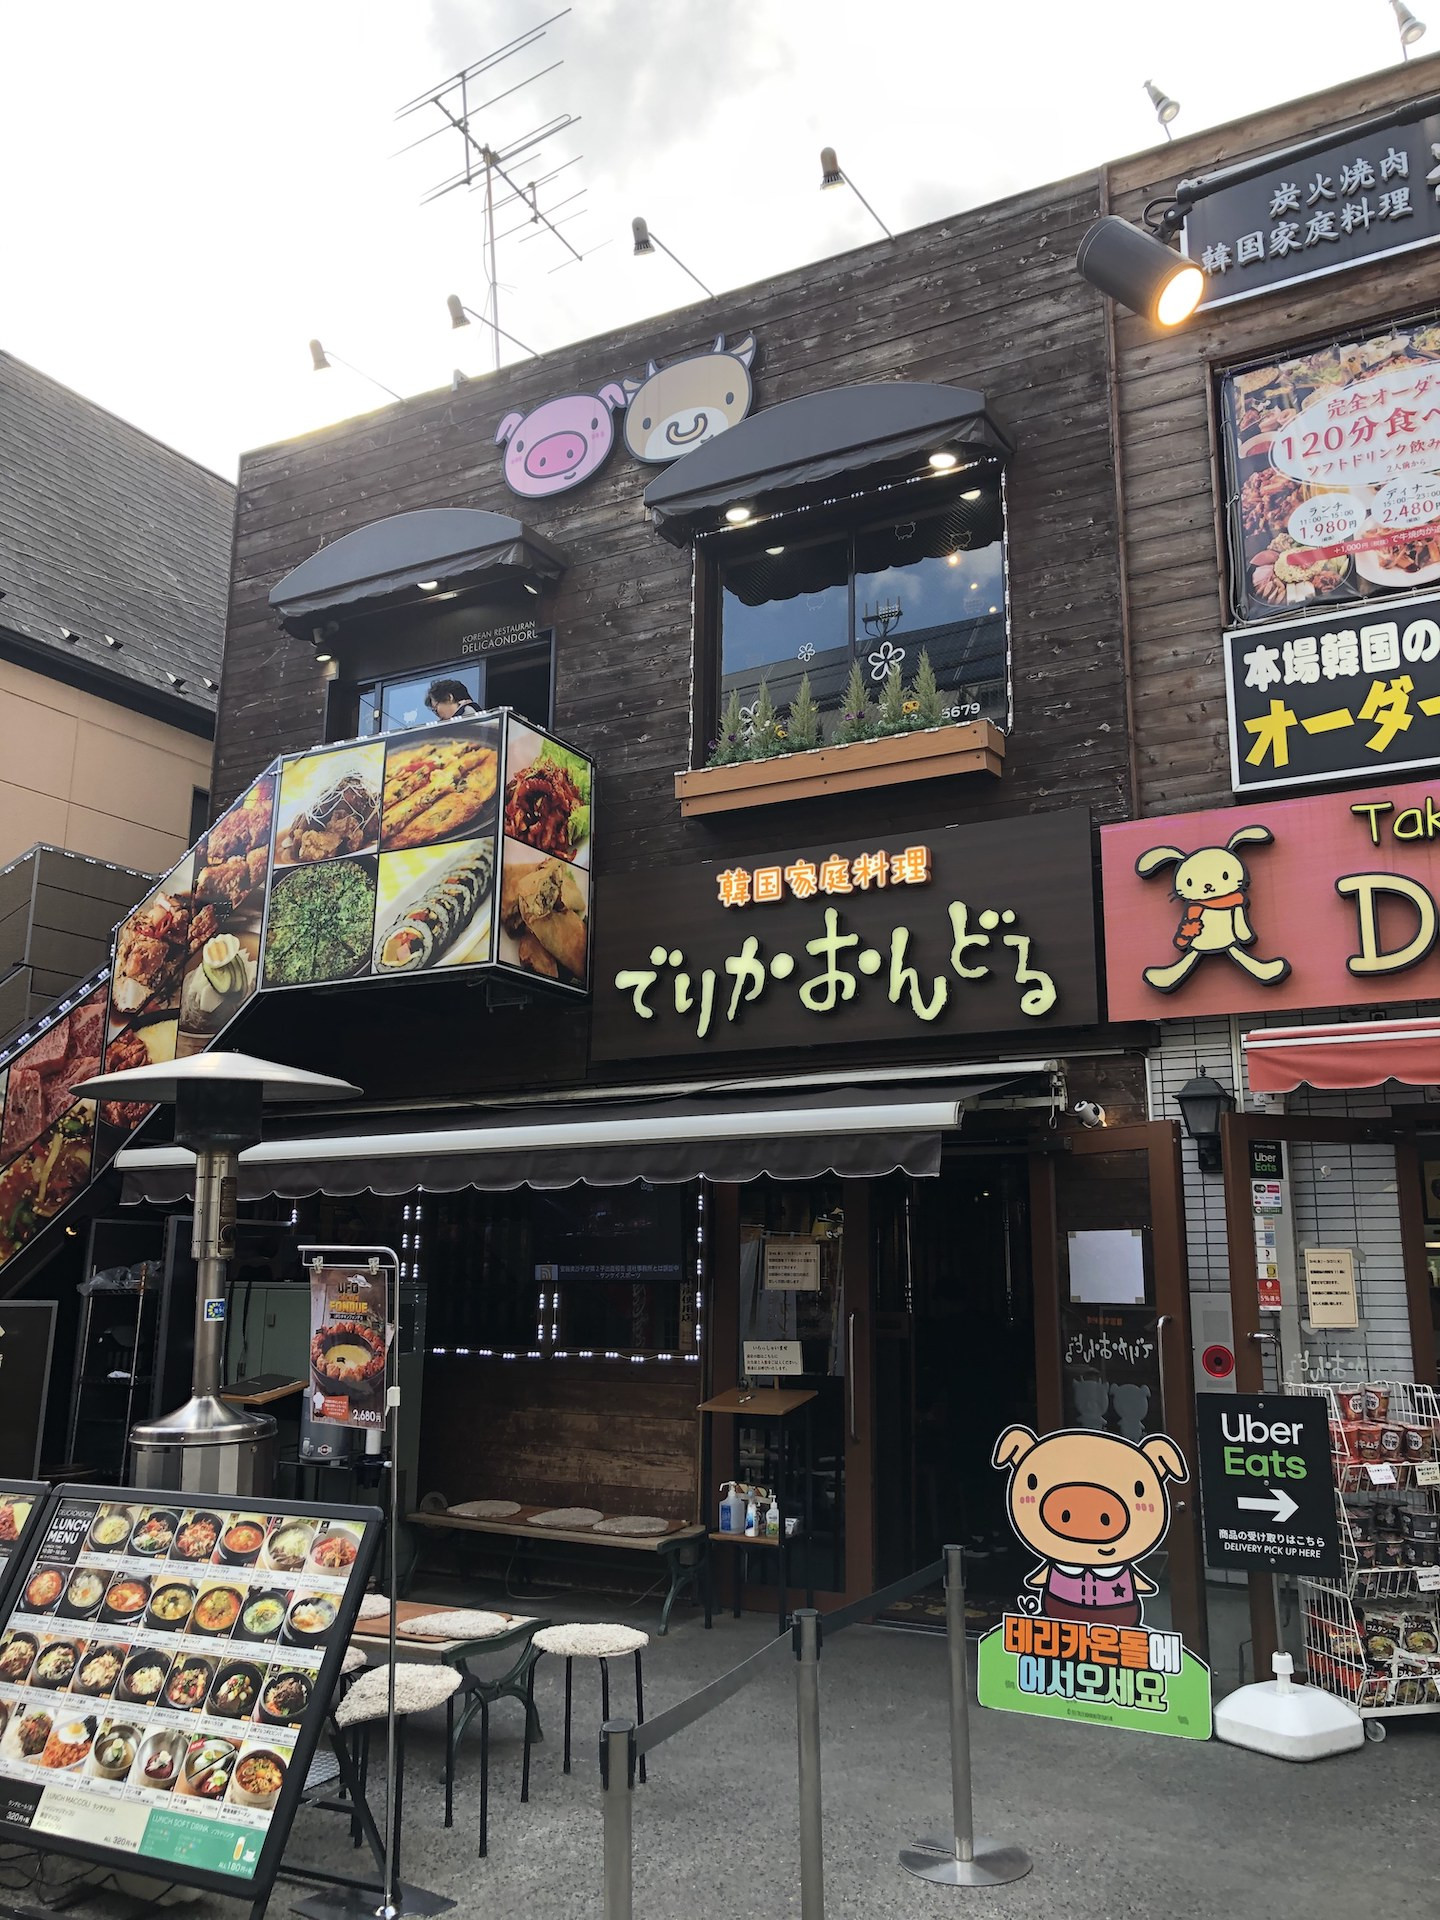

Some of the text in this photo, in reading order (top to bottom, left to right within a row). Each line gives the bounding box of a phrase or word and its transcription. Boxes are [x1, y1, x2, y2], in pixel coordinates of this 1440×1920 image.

[1269, 147, 1409, 218] 炭火焼肉
[1201, 186, 1414, 276] 韓国家庭料理
[1327, 374, 1440, 419] 完全オーダ
[1309, 501, 1343, 516] ランチ
[1300, 518, 1357, 540] 1,980円
[462, 630, 492, 644] KOREAN
[1243, 618, 1440, 693] 本場韓国の
[715, 844, 932, 908] 韓国家庭料理
[1335, 872, 1439, 977] D
[614, 900, 1058, 1038] でりかおんどる
[1254, 1152, 1276, 1163] Uber
[1255, 1162, 1277, 1172] Eats
[337, 1282, 359, 1294] UFO
[352, 1409, 382, 1422] 2,680円
[1221, 1412, 1304, 1445] Uber
[1223, 1446, 1308, 1480] Eats
[52, 1518, 92, 1532] LUNCH
[46, 1531, 80, 1545] MENU
[1218, 1528, 1326, 1548] 商品の受け取りはこちら
[1224, 1541, 1321, 1559] DELIVERY PICK UP HERE
[1004, 1616, 1181, 1675] 데리카온돌에
[1019, 1655, 1168, 1711] 어서오세요
[152, 1814, 173, 1825] LUNCH
[174, 1818, 190, 1829] SOFT
[190, 1822, 209, 1833] DRINK
